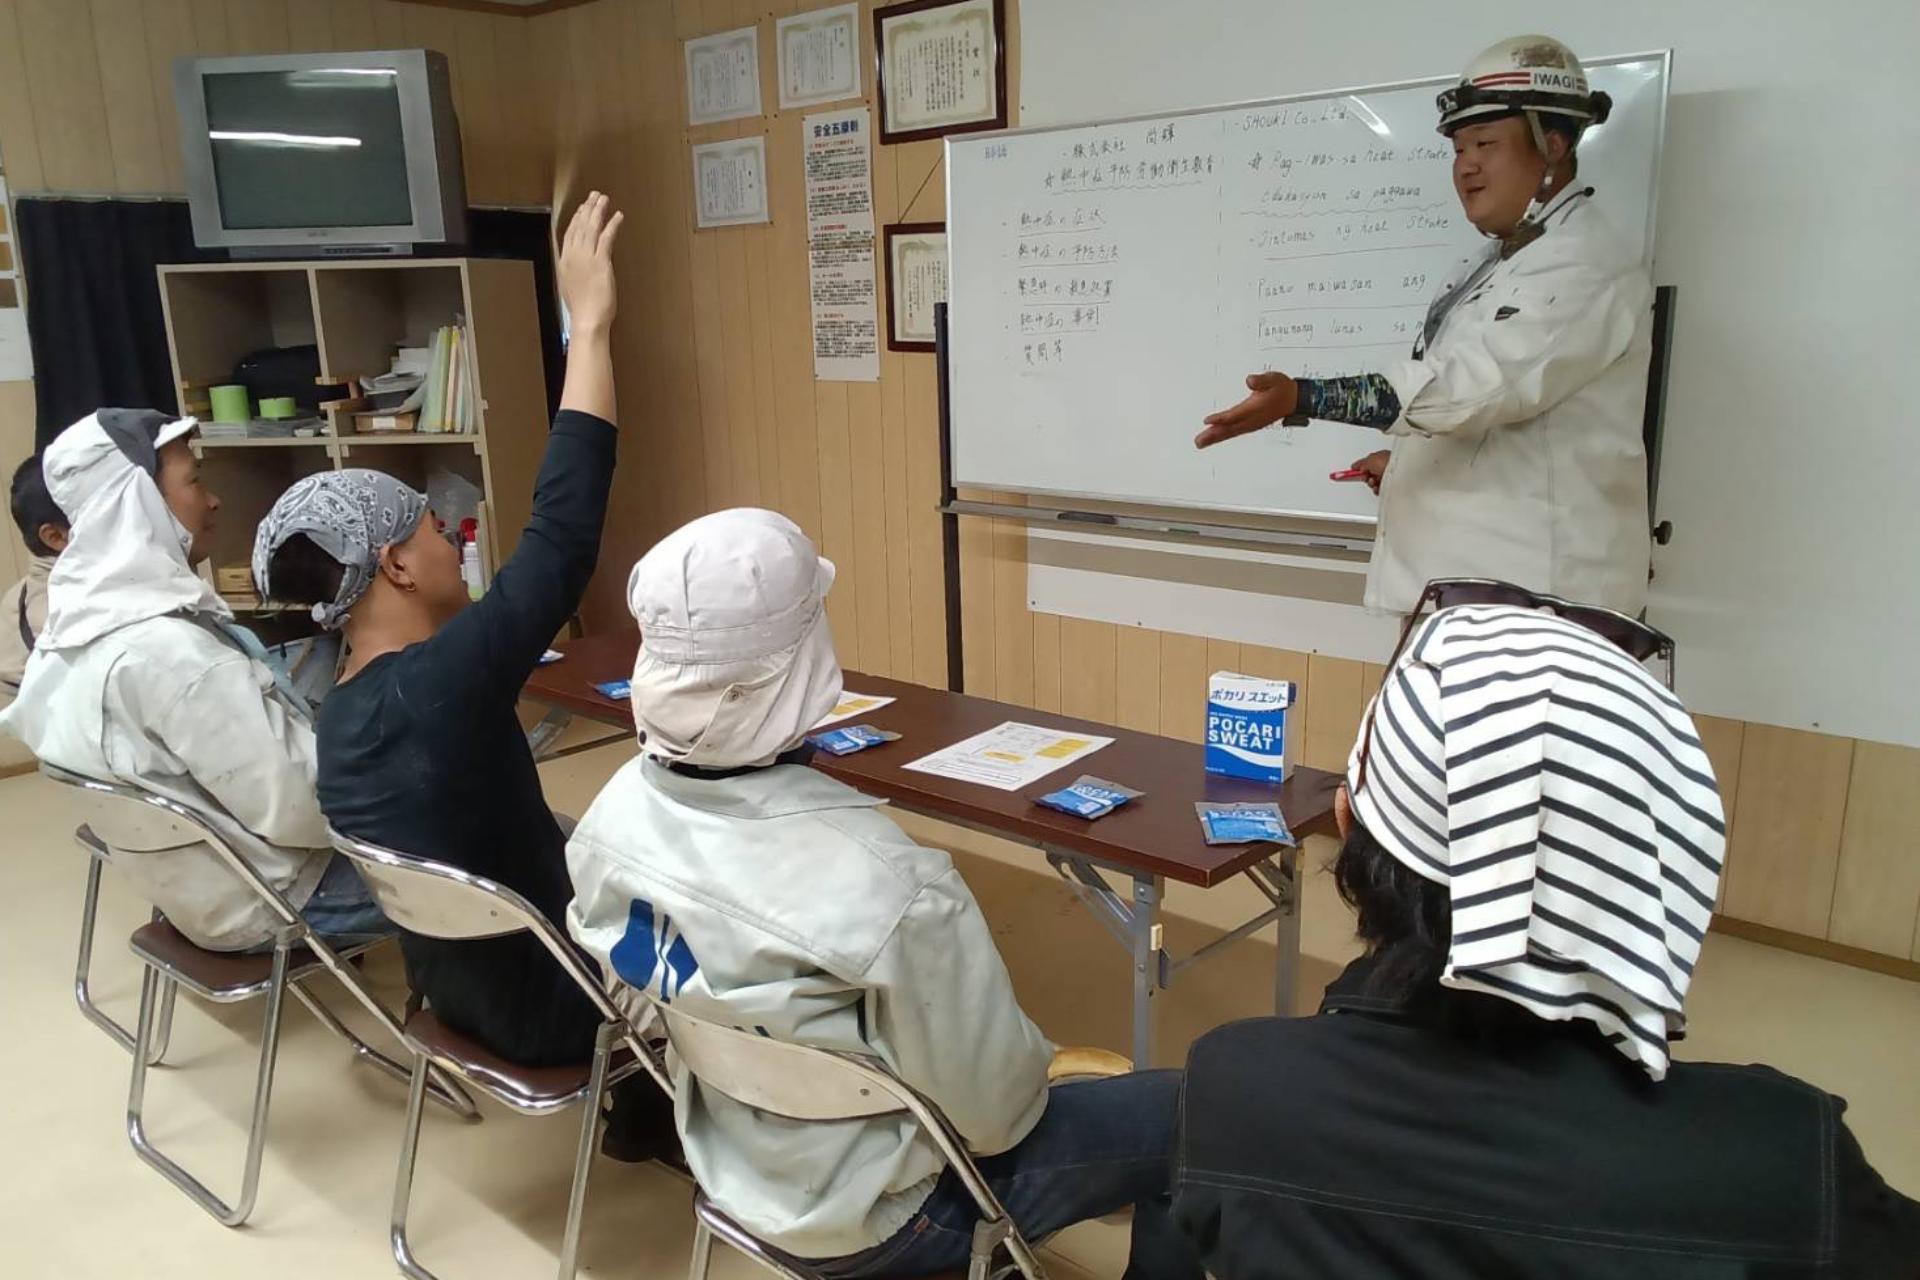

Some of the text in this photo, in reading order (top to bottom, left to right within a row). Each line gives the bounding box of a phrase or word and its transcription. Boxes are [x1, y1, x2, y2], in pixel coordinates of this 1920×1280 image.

[1210, 688, 1286, 704] ポカリ スエット
[1208, 716, 1281, 739] POCARI
[1208, 729, 1275, 751] SWEAT
